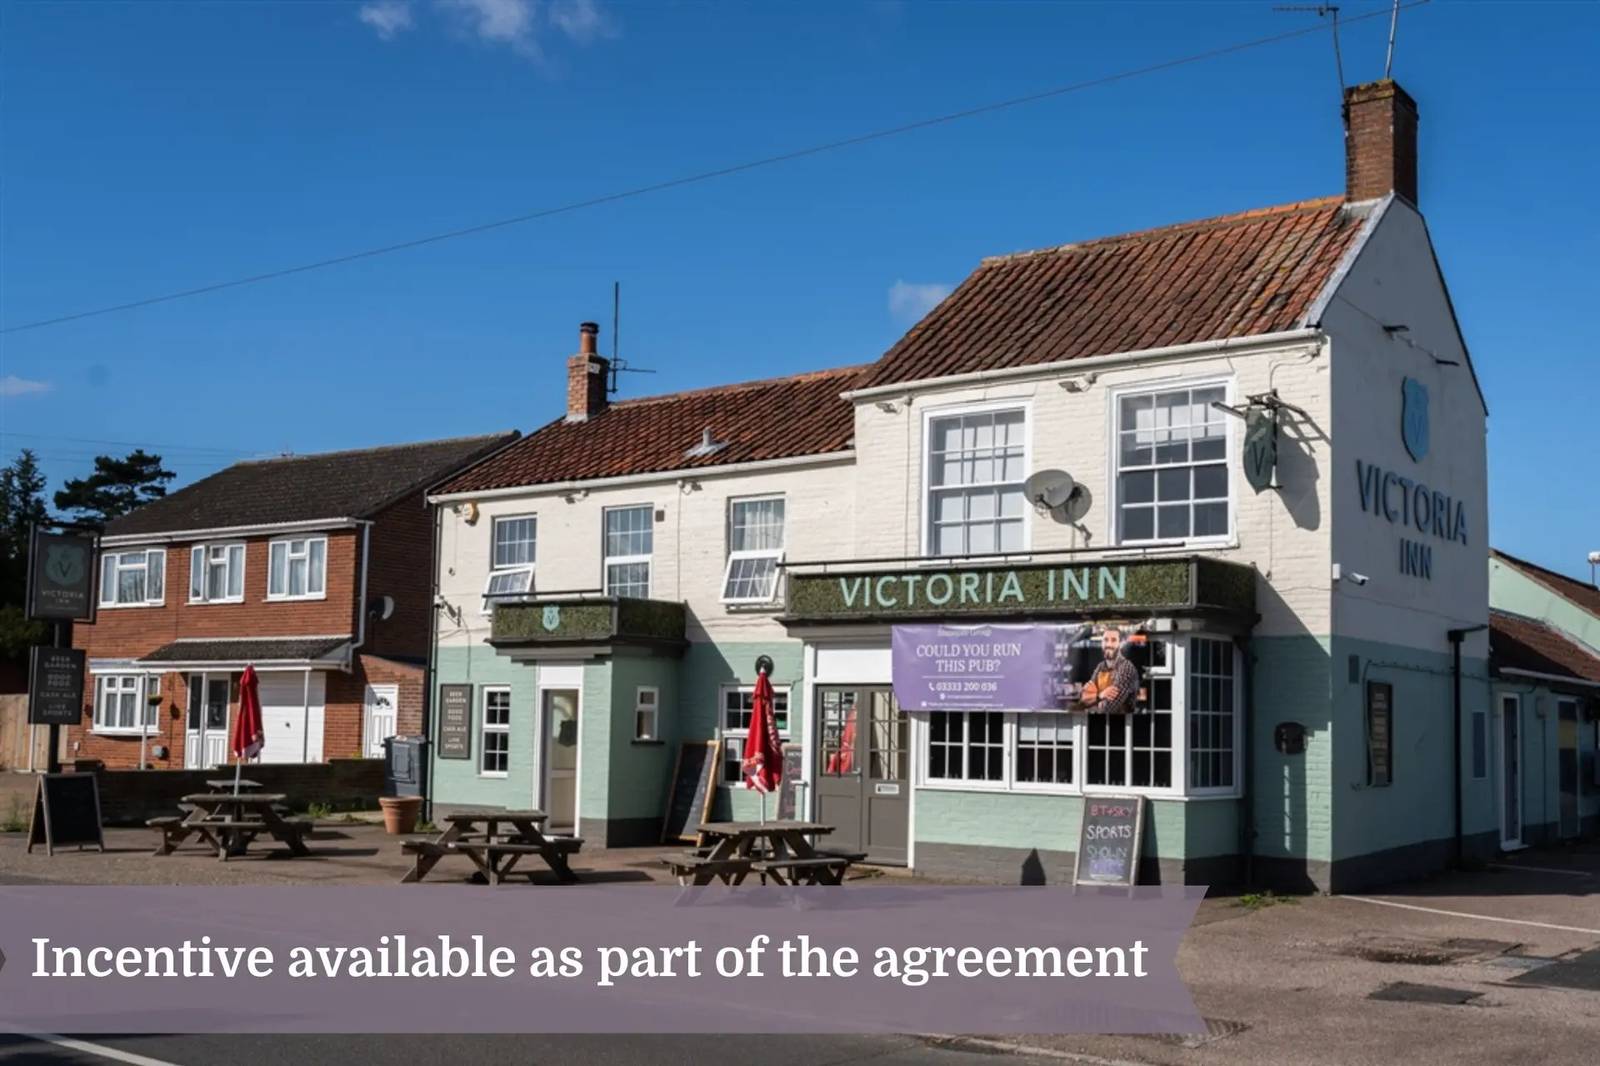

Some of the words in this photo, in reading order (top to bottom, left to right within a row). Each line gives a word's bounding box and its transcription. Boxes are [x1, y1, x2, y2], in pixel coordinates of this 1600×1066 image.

[1252, 441, 1266, 476] V
[1356, 459, 1468, 546] VICTORIA
[1400, 538, 1432, 580] INN
[42, 589, 84, 599] VICTORIA
[840, 570, 1025, 607] VICTORIA
[1048, 566, 1127, 600] INN
[916, 645, 960, 658] COULD
[962, 644, 991, 657] YOU
[993, 643, 1022, 656] RUN
[935, 659, 966, 673] THIS
[968, 659, 1002, 672] PUB?
[963, 682, 980, 691] 200
[1087, 824, 1132, 840] SPORTS
